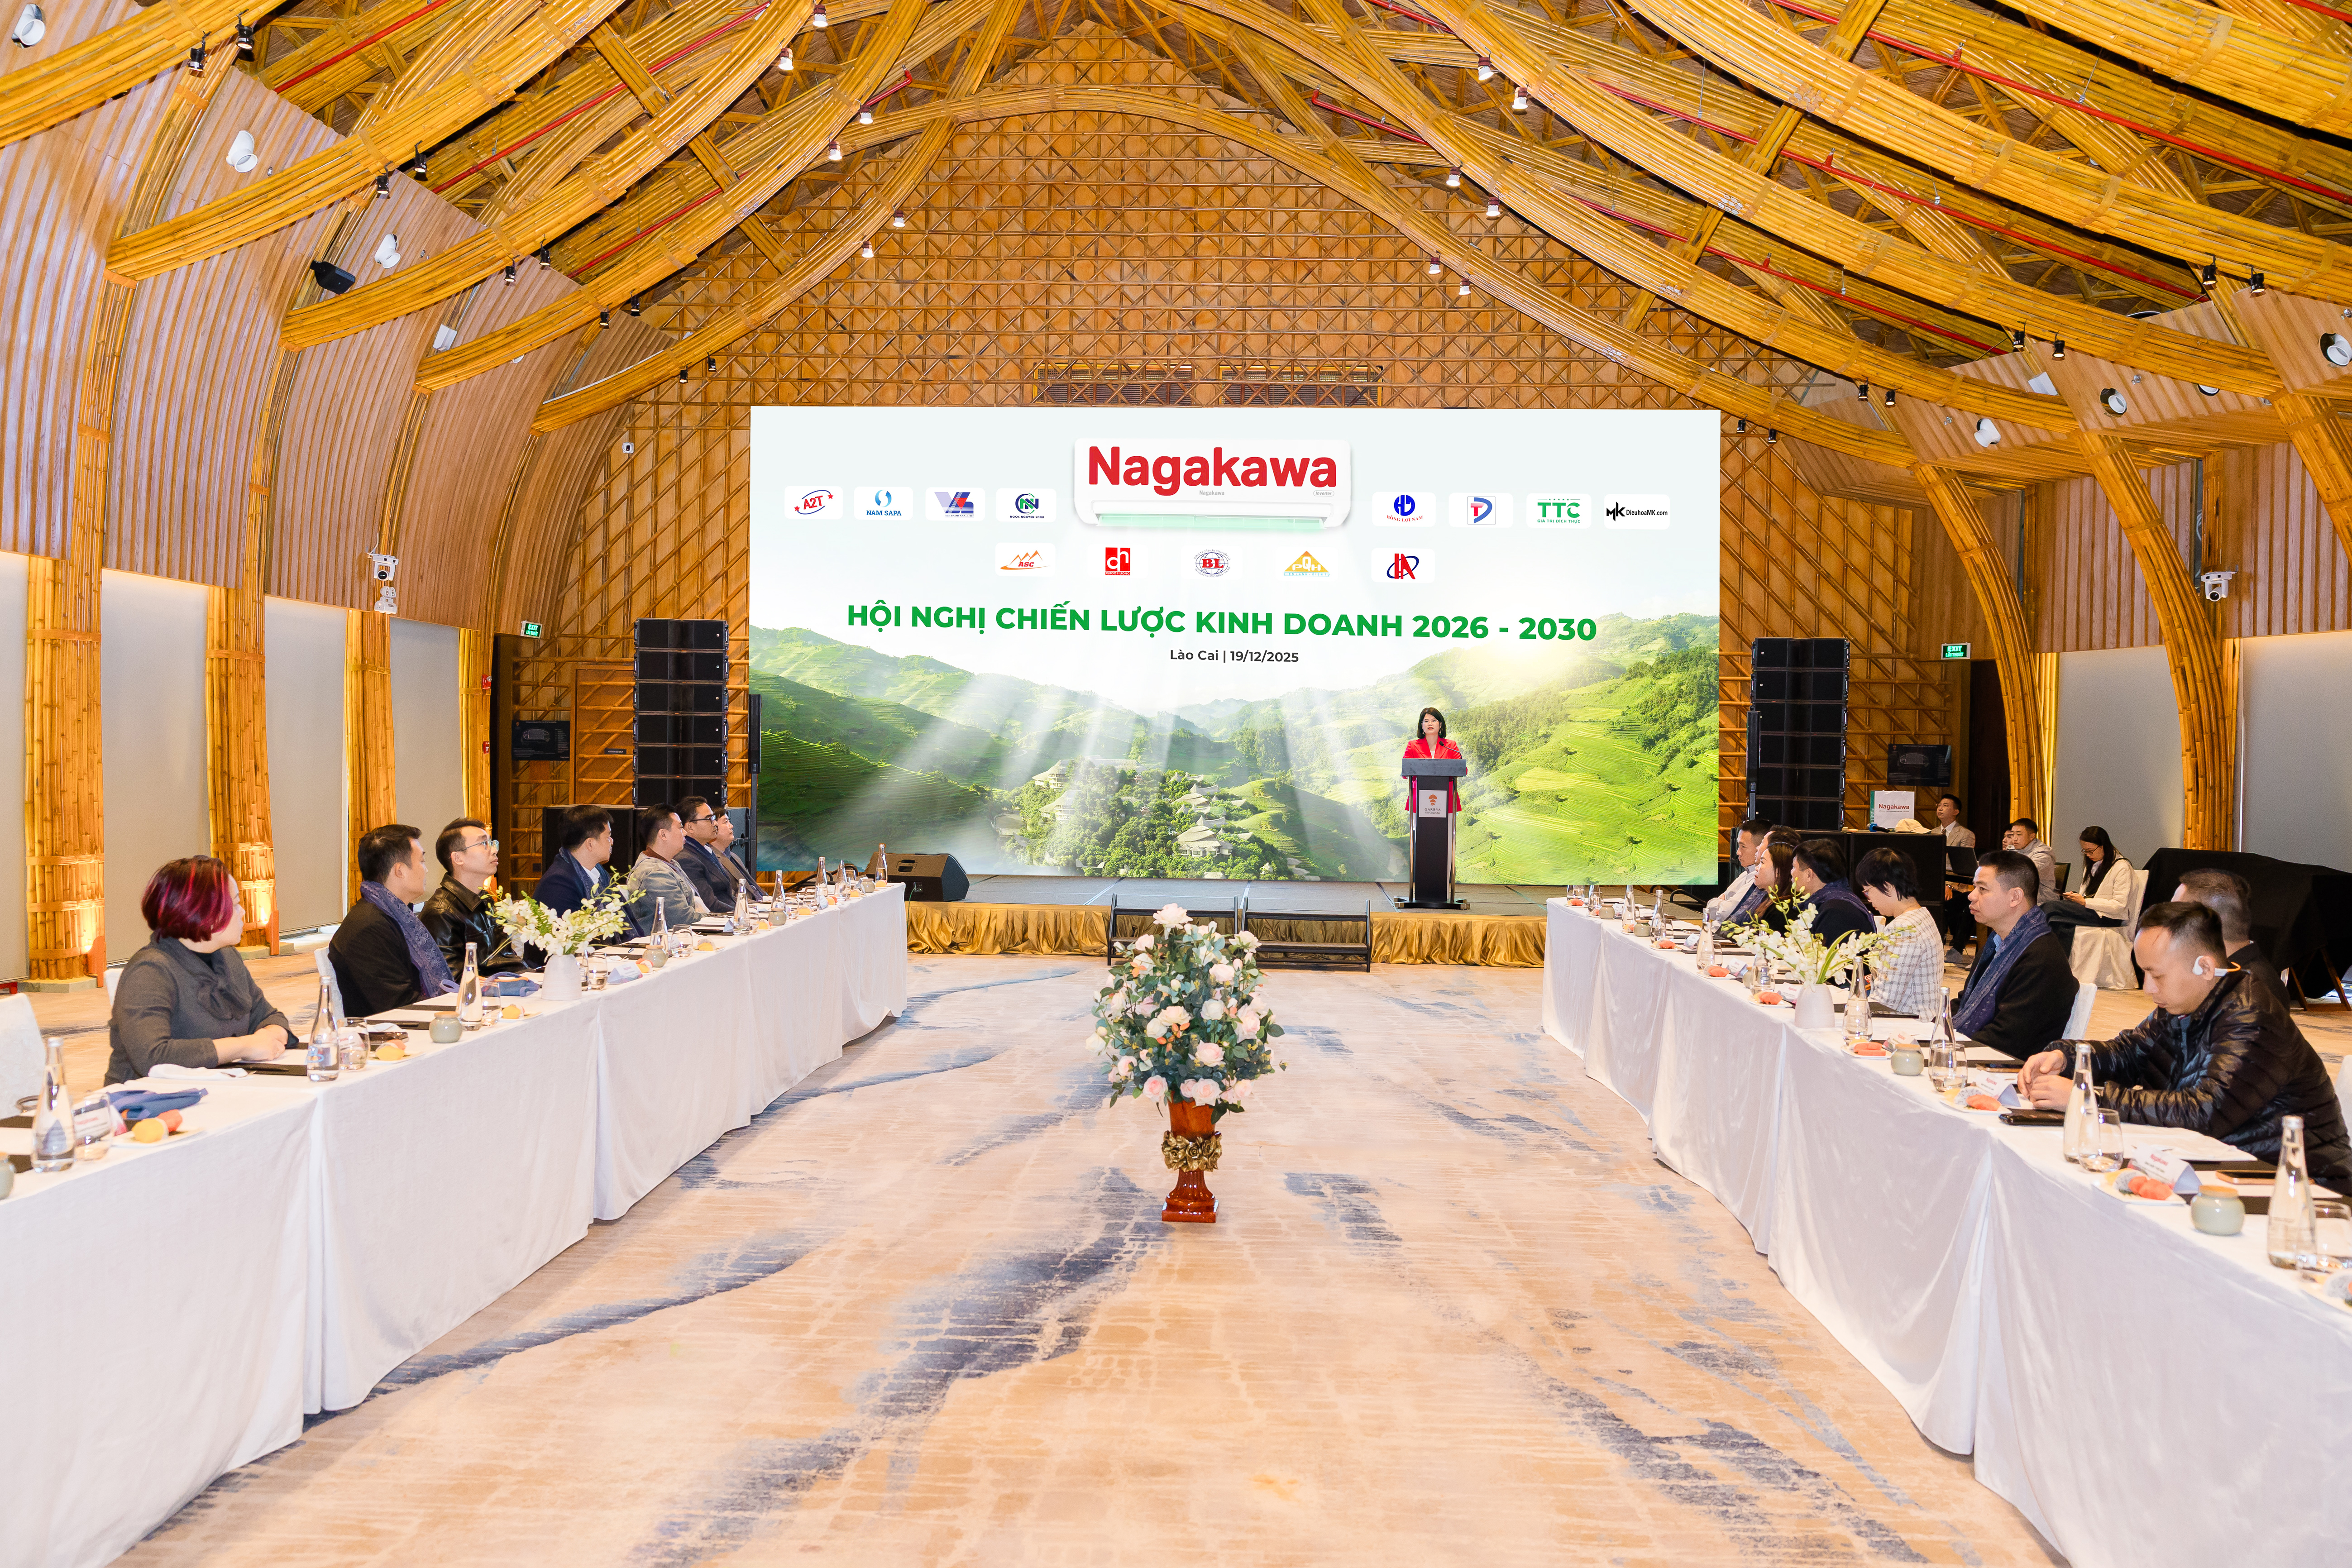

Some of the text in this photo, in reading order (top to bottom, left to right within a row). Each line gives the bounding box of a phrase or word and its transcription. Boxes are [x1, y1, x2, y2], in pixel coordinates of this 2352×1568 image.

[1089, 446, 1337, 496] Nagakawa
[803, 495, 823, 510] A2T
[1537, 502, 1580, 518] TTC
[1202, 559, 1224, 569] BL
[1292, 556, 1321, 572] PQH
[848, 599, 900, 632] HỘI
[912, 607, 985, 635] NGHỊ
[996, 601, 1090, 631] CHIẾN
[1101, 606, 1186, 638] LƯỢC
[1196, 612, 1272, 634] KINH
[1285, 613, 1402, 637] DOANH
[1413, 615, 1489, 639] 2026
[1519, 617, 1597, 641] 2030
[1171, 650, 1194, 660] Lào
[1198, 650, 1219, 660] Cai
[1230, 650, 1299, 663] 19/12/2025
